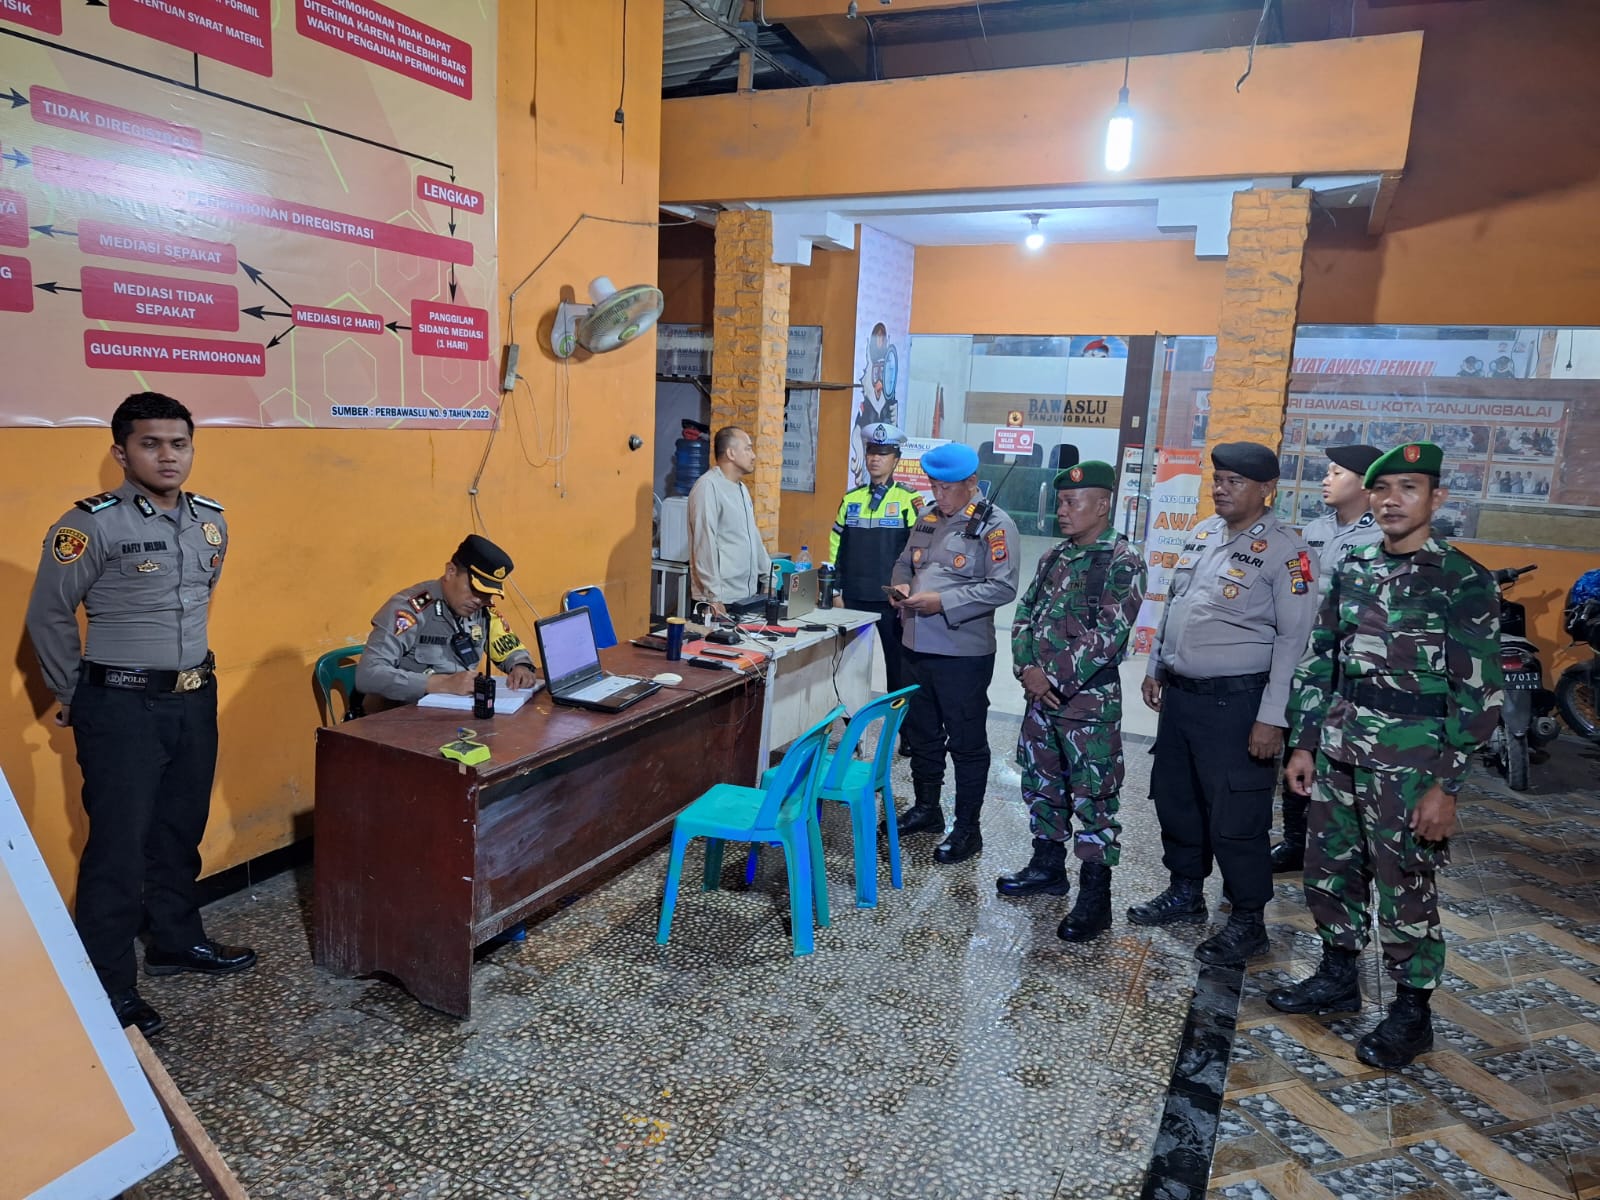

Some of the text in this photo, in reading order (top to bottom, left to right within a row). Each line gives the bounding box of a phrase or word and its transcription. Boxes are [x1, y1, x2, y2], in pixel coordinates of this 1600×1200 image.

[187, 12, 224, 33] SYARAT
[225, 26, 265, 49] MATERIL
[304, 0, 467, 74] DITERIMA KARENA MELEBIHI BATAS
[396, 22, 423, 41] TIDAK
[425, 34, 451, 53] DAPAT
[306, 15, 465, 87] WAKTU PENGAJUAN PERMOHONAN
[42, 100, 91, 124] TIDAK
[423, 182, 478, 208] LENGKAP
[291, 213, 375, 240] DIREGISTRASI
[99, 234, 223, 264] MEDIASI SEPAKAT
[113, 282, 215, 305] MEDIASI TIDAK
[135, 302, 197, 320] SEPAKAT
[296, 310, 381, 332] MEDIASI (2 HARI)
[429, 311, 475, 326] PANGGILAN
[418, 323, 484, 339] SIDANG MEDIASI
[90, 342, 262, 366] GUGURNYA PERMOHONAN
[436, 341, 469, 352] (1 HARI)
[1324, 358, 1378, 376] AWASI
[1379, 360, 1435, 377] PEMILU
[331, 406, 369, 417] SUMBER
[375, 408, 428, 419] PERBAWASLU
[429, 409, 443, 419] NO.
[443, 410, 448, 418] 9
[449, 410, 471, 419] TAHUN
[472, 410, 490, 420] 2022
[1028, 398, 1108, 415] BAWASLU
[1304, 399, 1379, 412] BAWASLU
[1381, 401, 1422, 414] KOTA
[1426, 402, 1553, 418] TANJUNGBALAI
[1027, 413, 1106, 425] TANJUNGBALAI
[1230, 551, 1264, 568] POLRI
